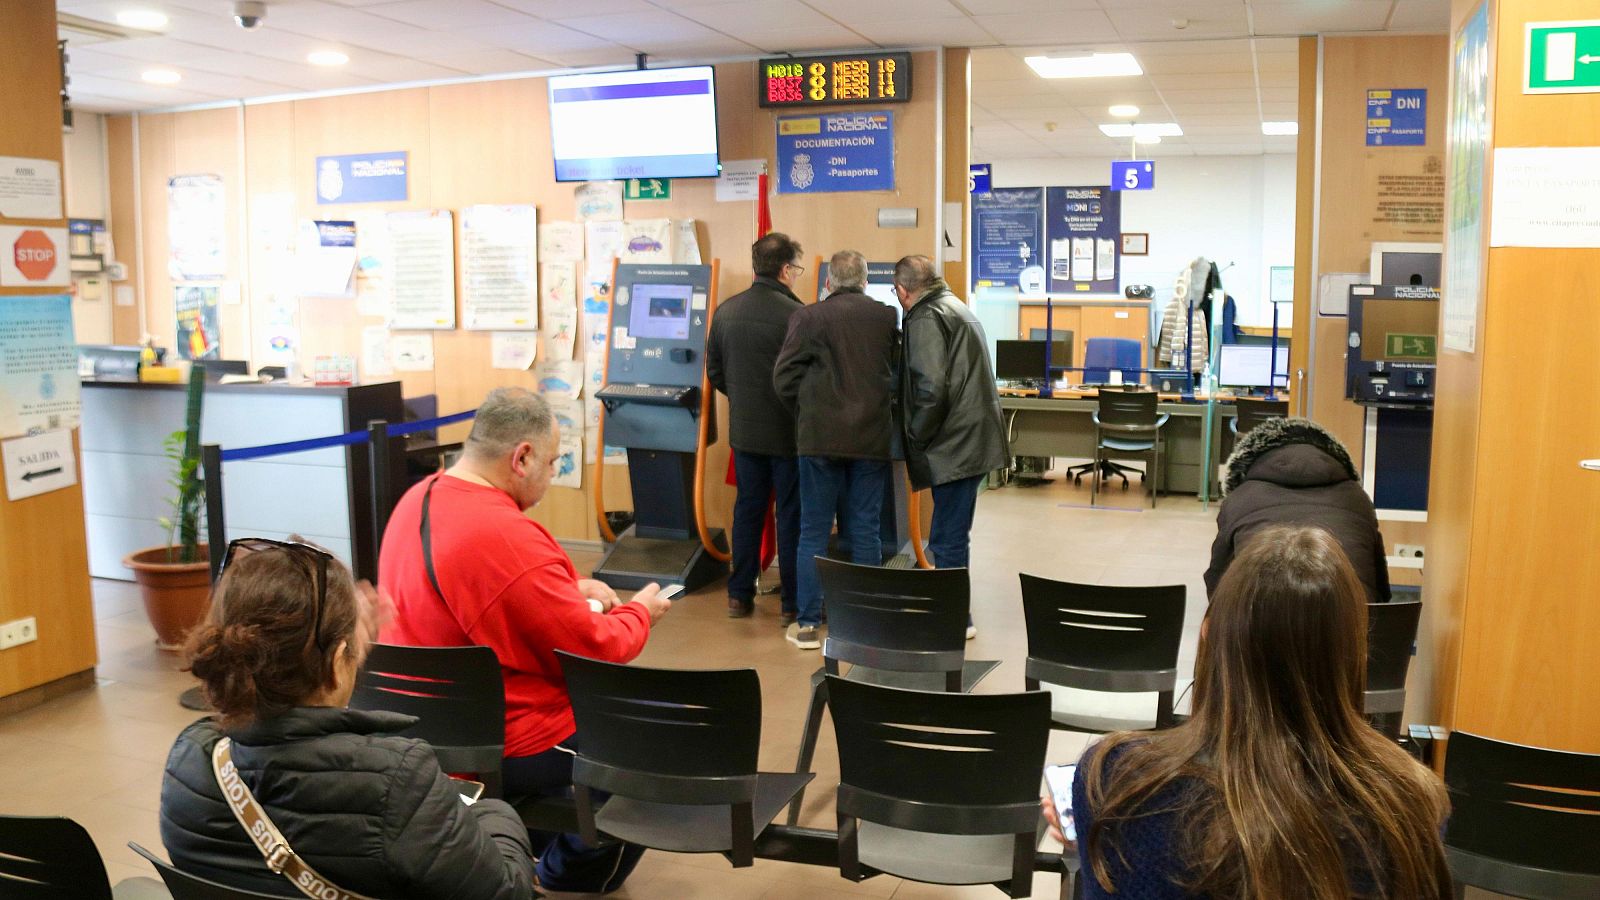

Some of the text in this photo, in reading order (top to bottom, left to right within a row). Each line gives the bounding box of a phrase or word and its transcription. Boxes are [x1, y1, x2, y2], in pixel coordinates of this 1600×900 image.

[767, 63, 803, 78] H018
[832, 60, 869, 75] MESA
[767, 72, 894, 91] B037 MESA 11
[767, 84, 896, 102] B036 MESA 14
[1396, 97, 1421, 110] DNI
[827, 122, 888, 132] NACIONAL
[795, 135, 875, 149] DOCUMENTACIÓN
[1125, 168, 1139, 188] 5
[18, 249, 54, 261] STOP
[18, 450, 60, 464] SALIDA
[220, 760, 249, 815] TOUS
